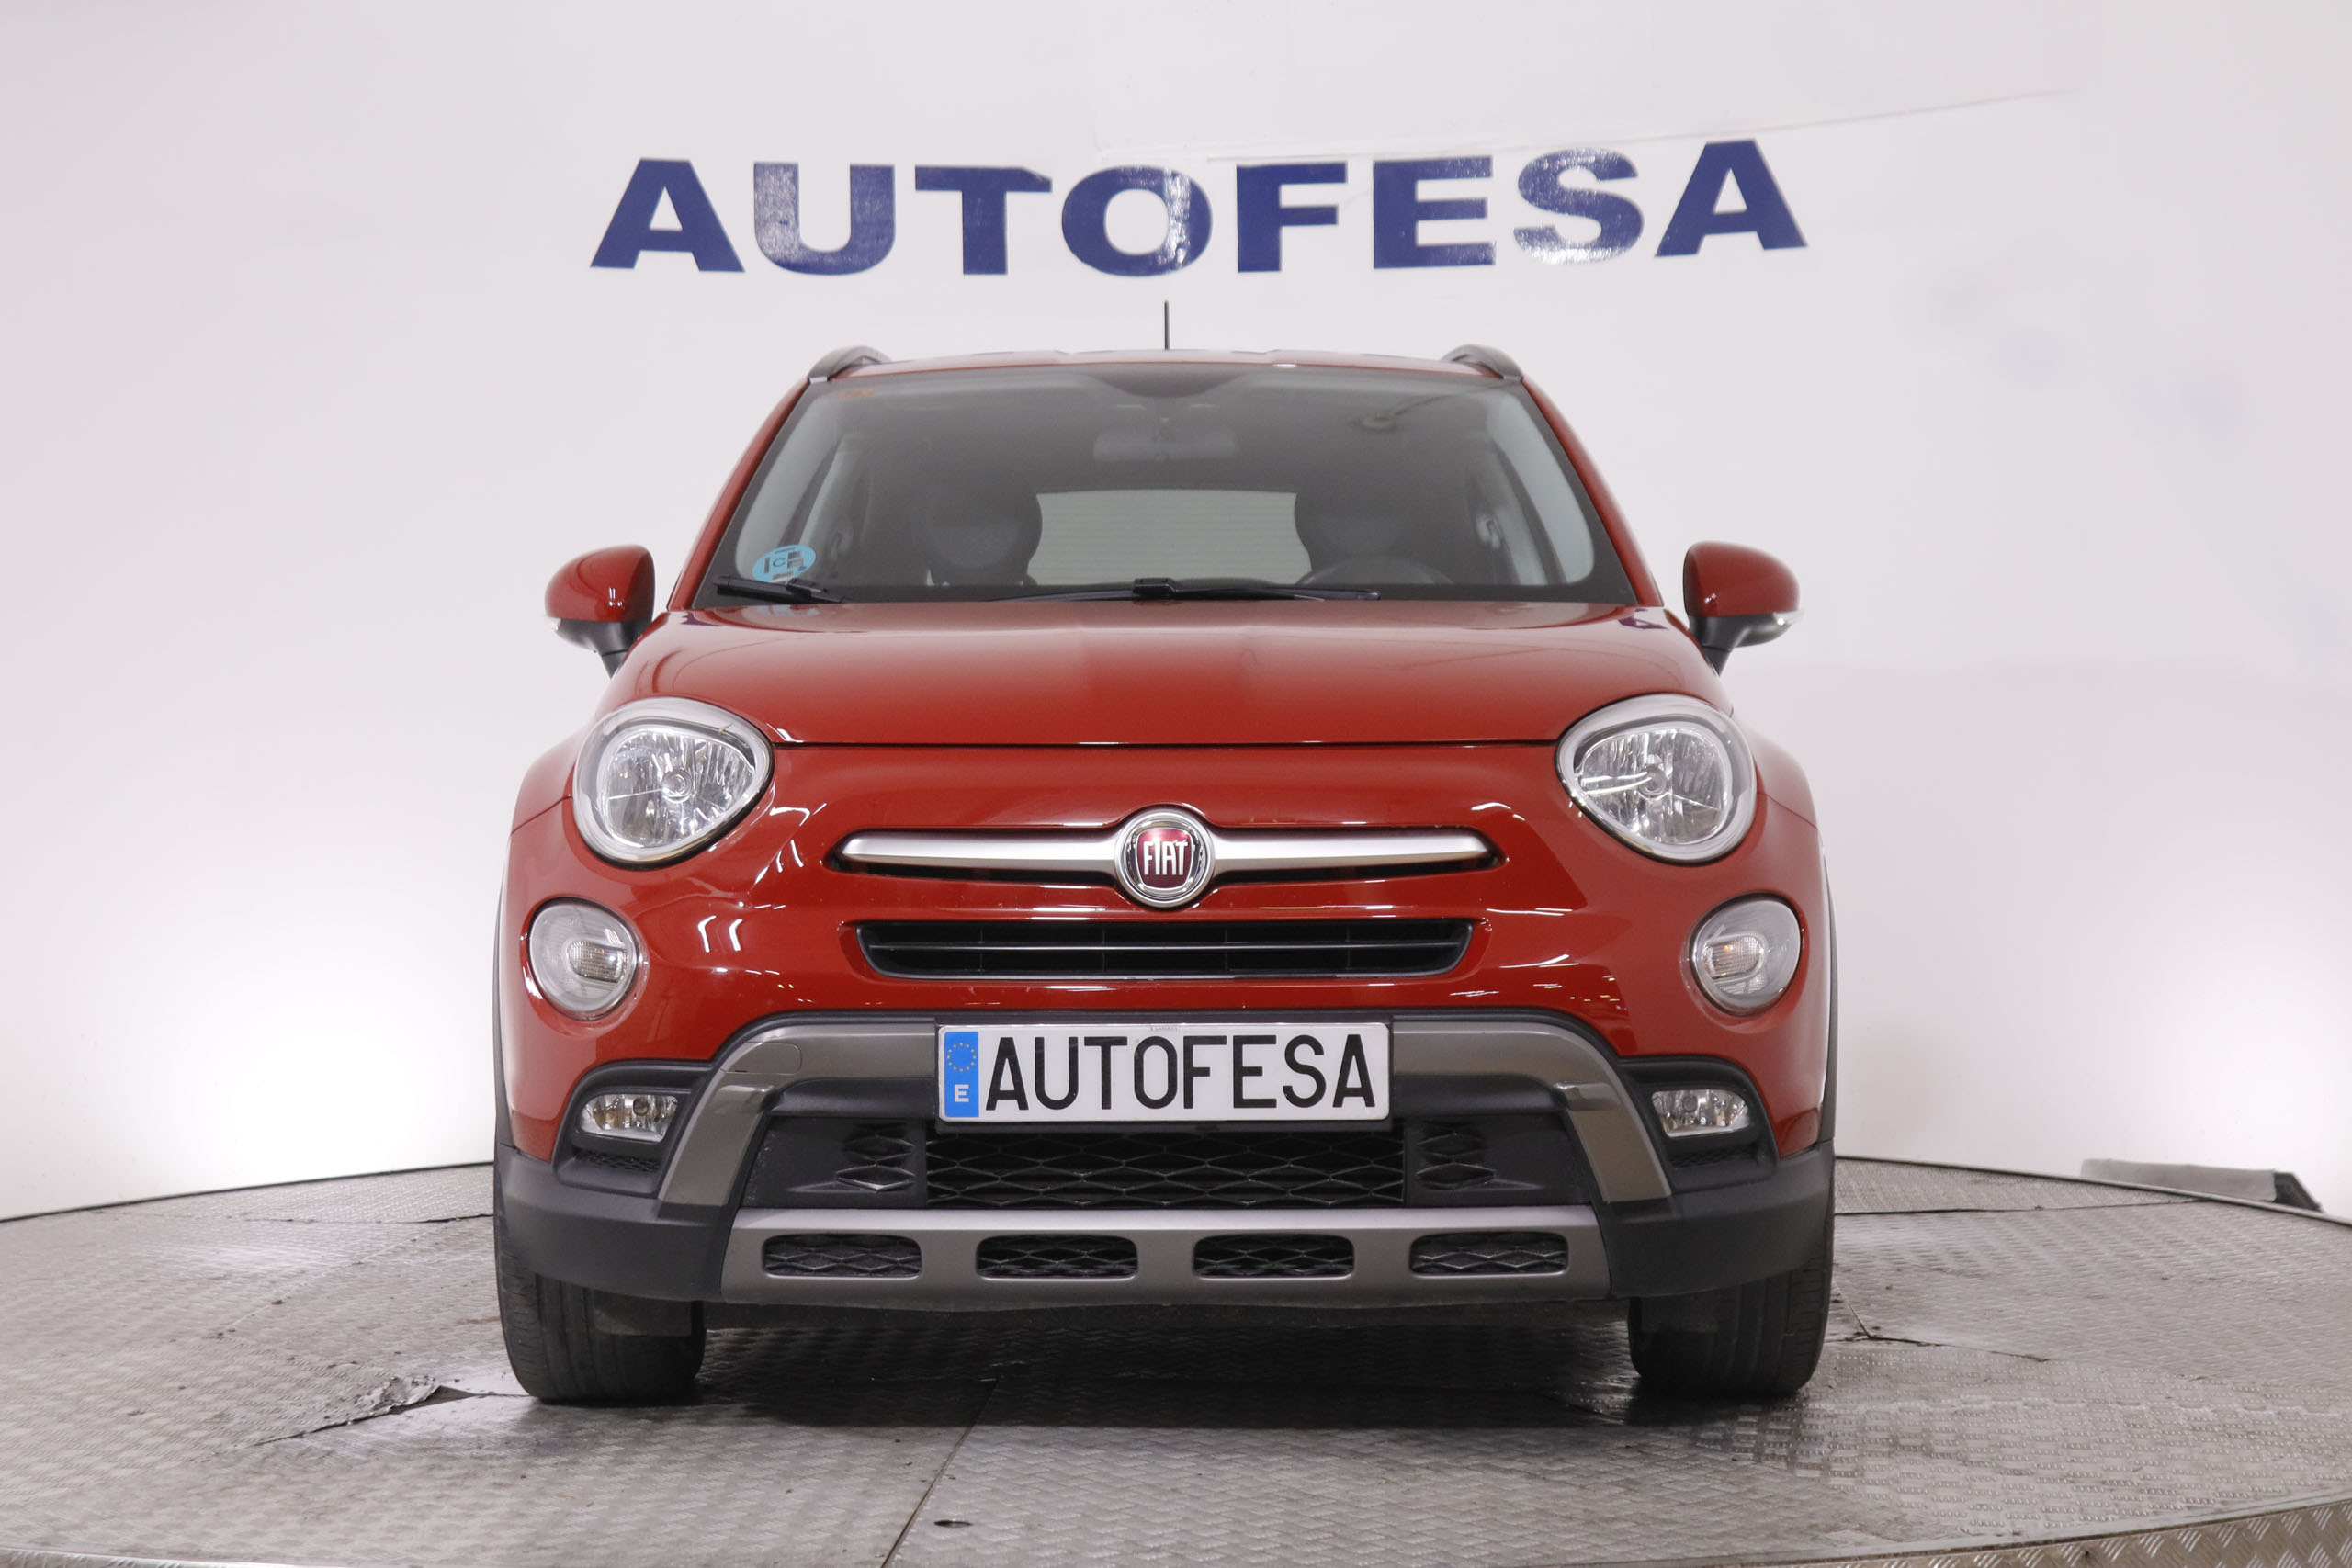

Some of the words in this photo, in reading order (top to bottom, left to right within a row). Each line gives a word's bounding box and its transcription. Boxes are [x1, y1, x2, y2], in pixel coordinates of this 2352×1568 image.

[591, 140, 1807, 276] AUTOFESA
[1143, 839, 1189, 875] FIAT
[954, 1084, 969, 1102] E
[985, 1033, 1376, 1111] AUTOFESA
